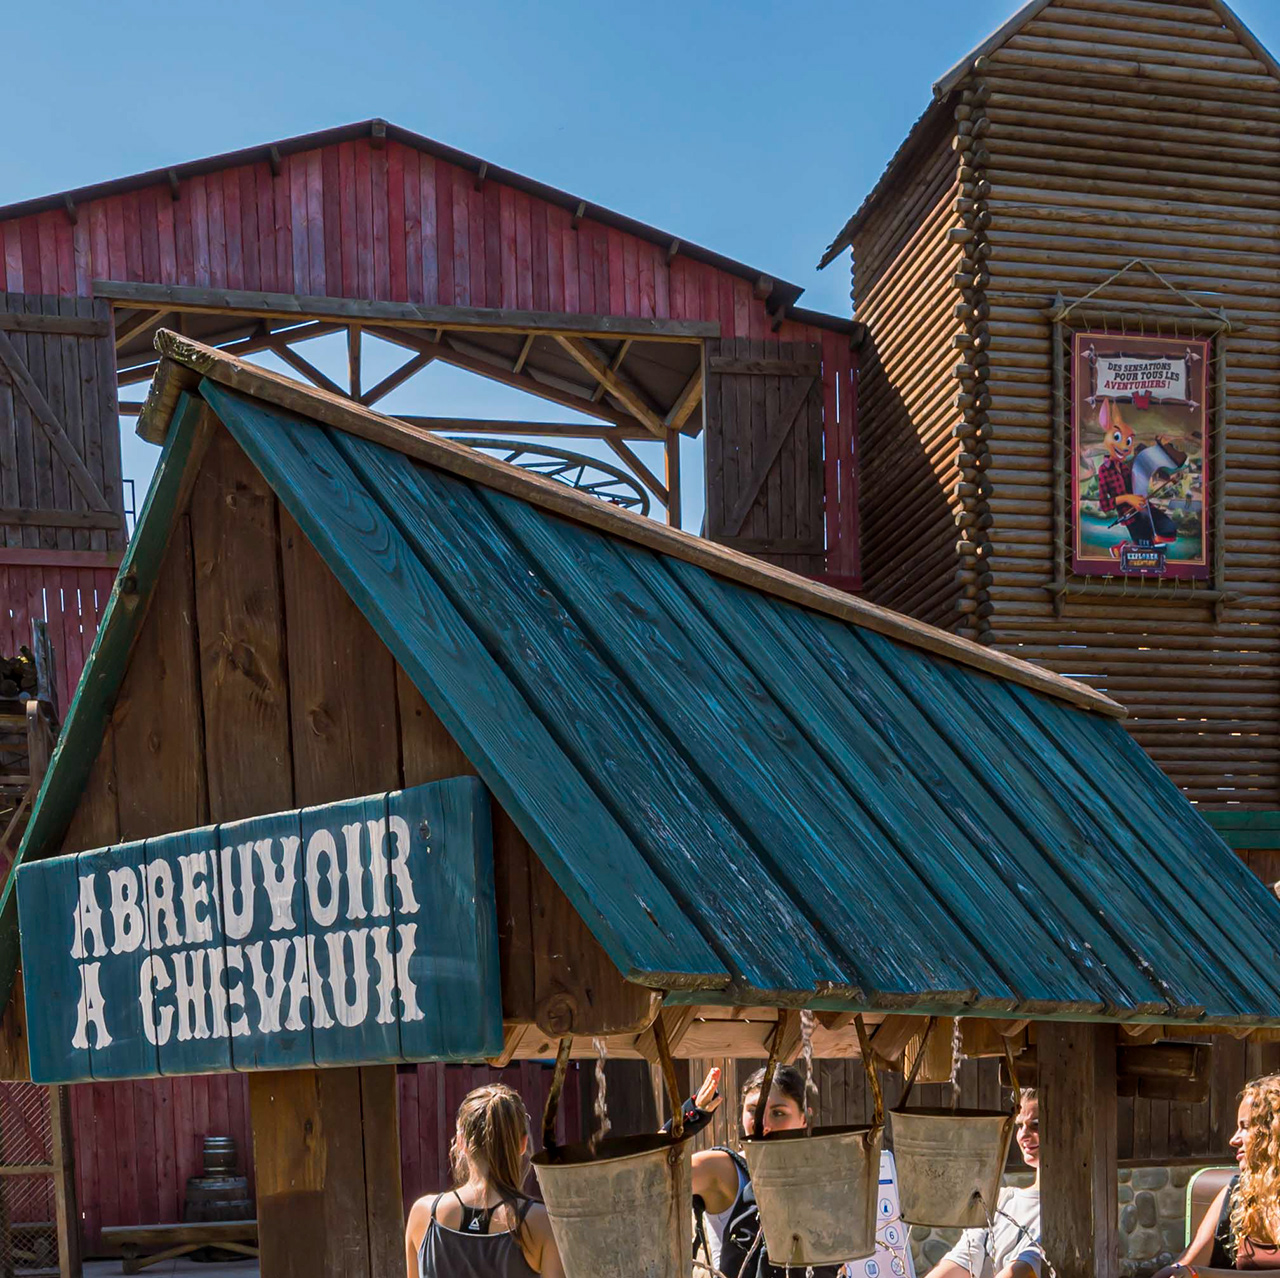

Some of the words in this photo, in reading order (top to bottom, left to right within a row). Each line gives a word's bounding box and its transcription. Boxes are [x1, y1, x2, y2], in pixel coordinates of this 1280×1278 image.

[1108, 362, 1122, 372] DES
[1124, 363, 1171, 372] SENSATIONS
[1114, 373, 1138, 381] POUR
[1140, 371, 1164, 380] TOUS
[1165, 371, 1180, 382] LES
[1104, 380, 1166, 390] AVENTURIERS
[70, 815, 421, 959] ABREUVOIR
[71, 961, 113, 1050] A
[138, 922, 426, 1047] CHEVAUX
[889, 1231, 895, 1240] 6
